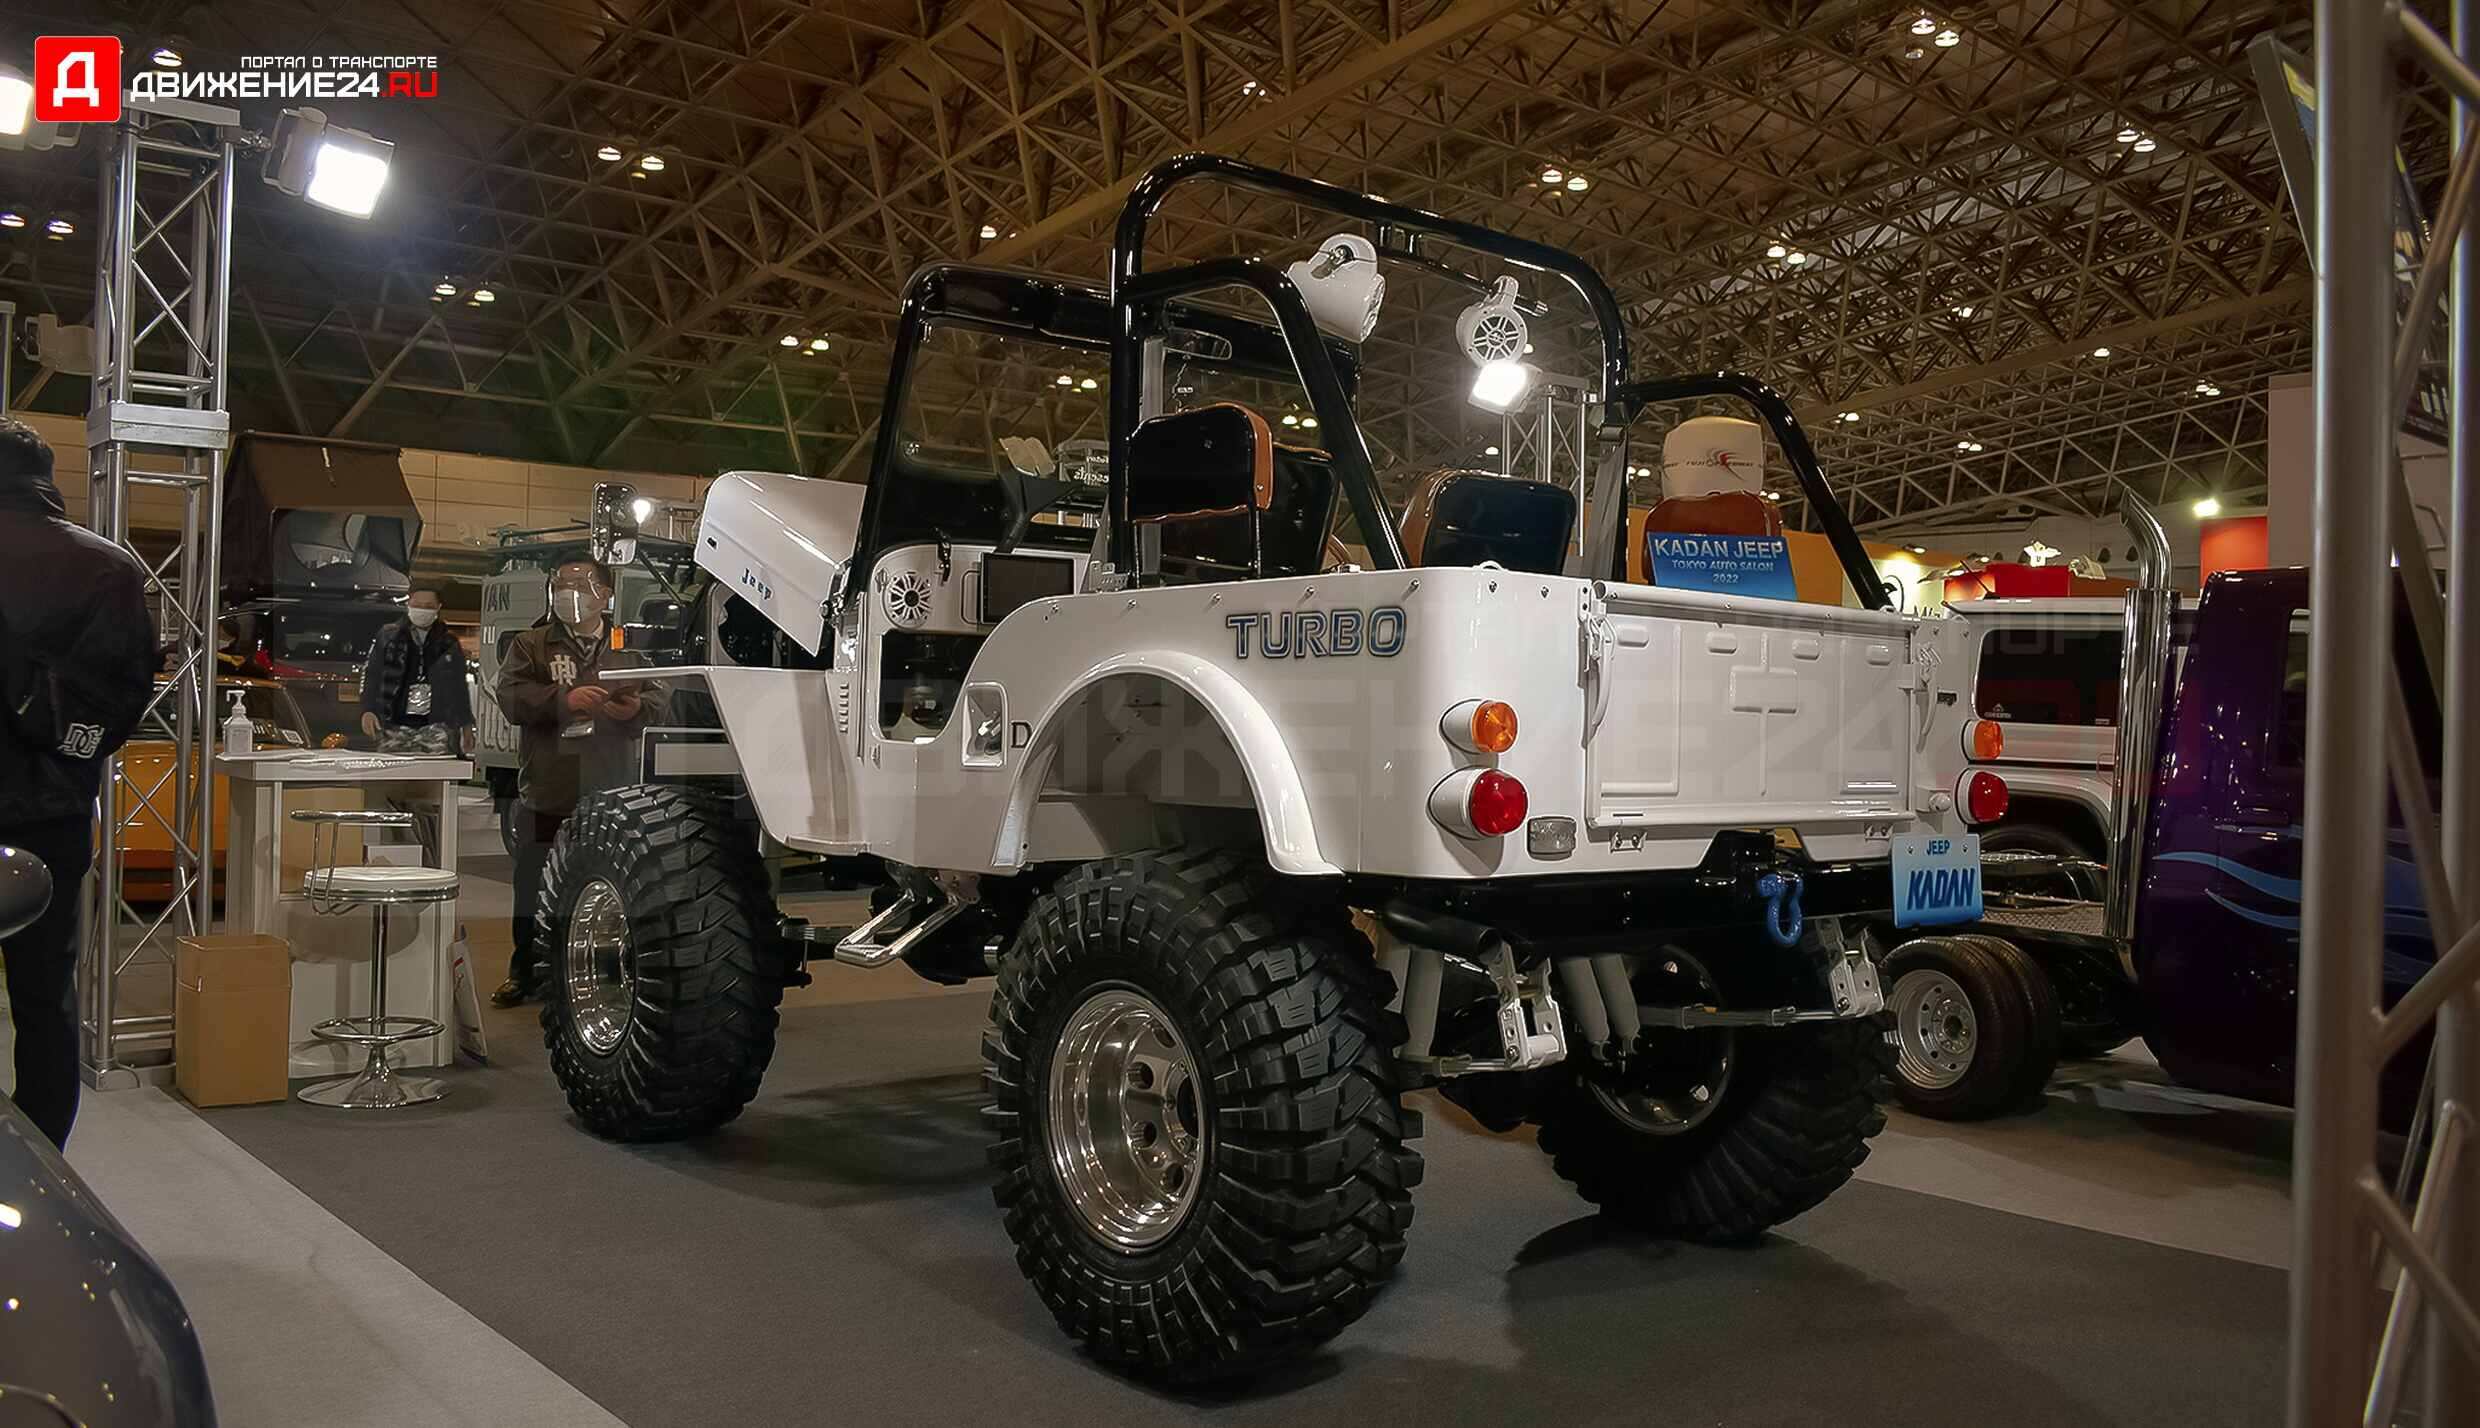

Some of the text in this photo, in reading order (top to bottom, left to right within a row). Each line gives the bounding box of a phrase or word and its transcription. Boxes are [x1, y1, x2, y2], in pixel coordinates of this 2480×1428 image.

[1654, 538, 1784, 560] KADAN JEEP
[1671, 559, 1775, 573] TOKYO AUTO SALON
[1712, 573, 1739, 583] 2022
[1226, 606, 1407, 660] TURBO
[1926, 839, 1951, 856] JEEP
[1907, 867, 1975, 911] KADAN
